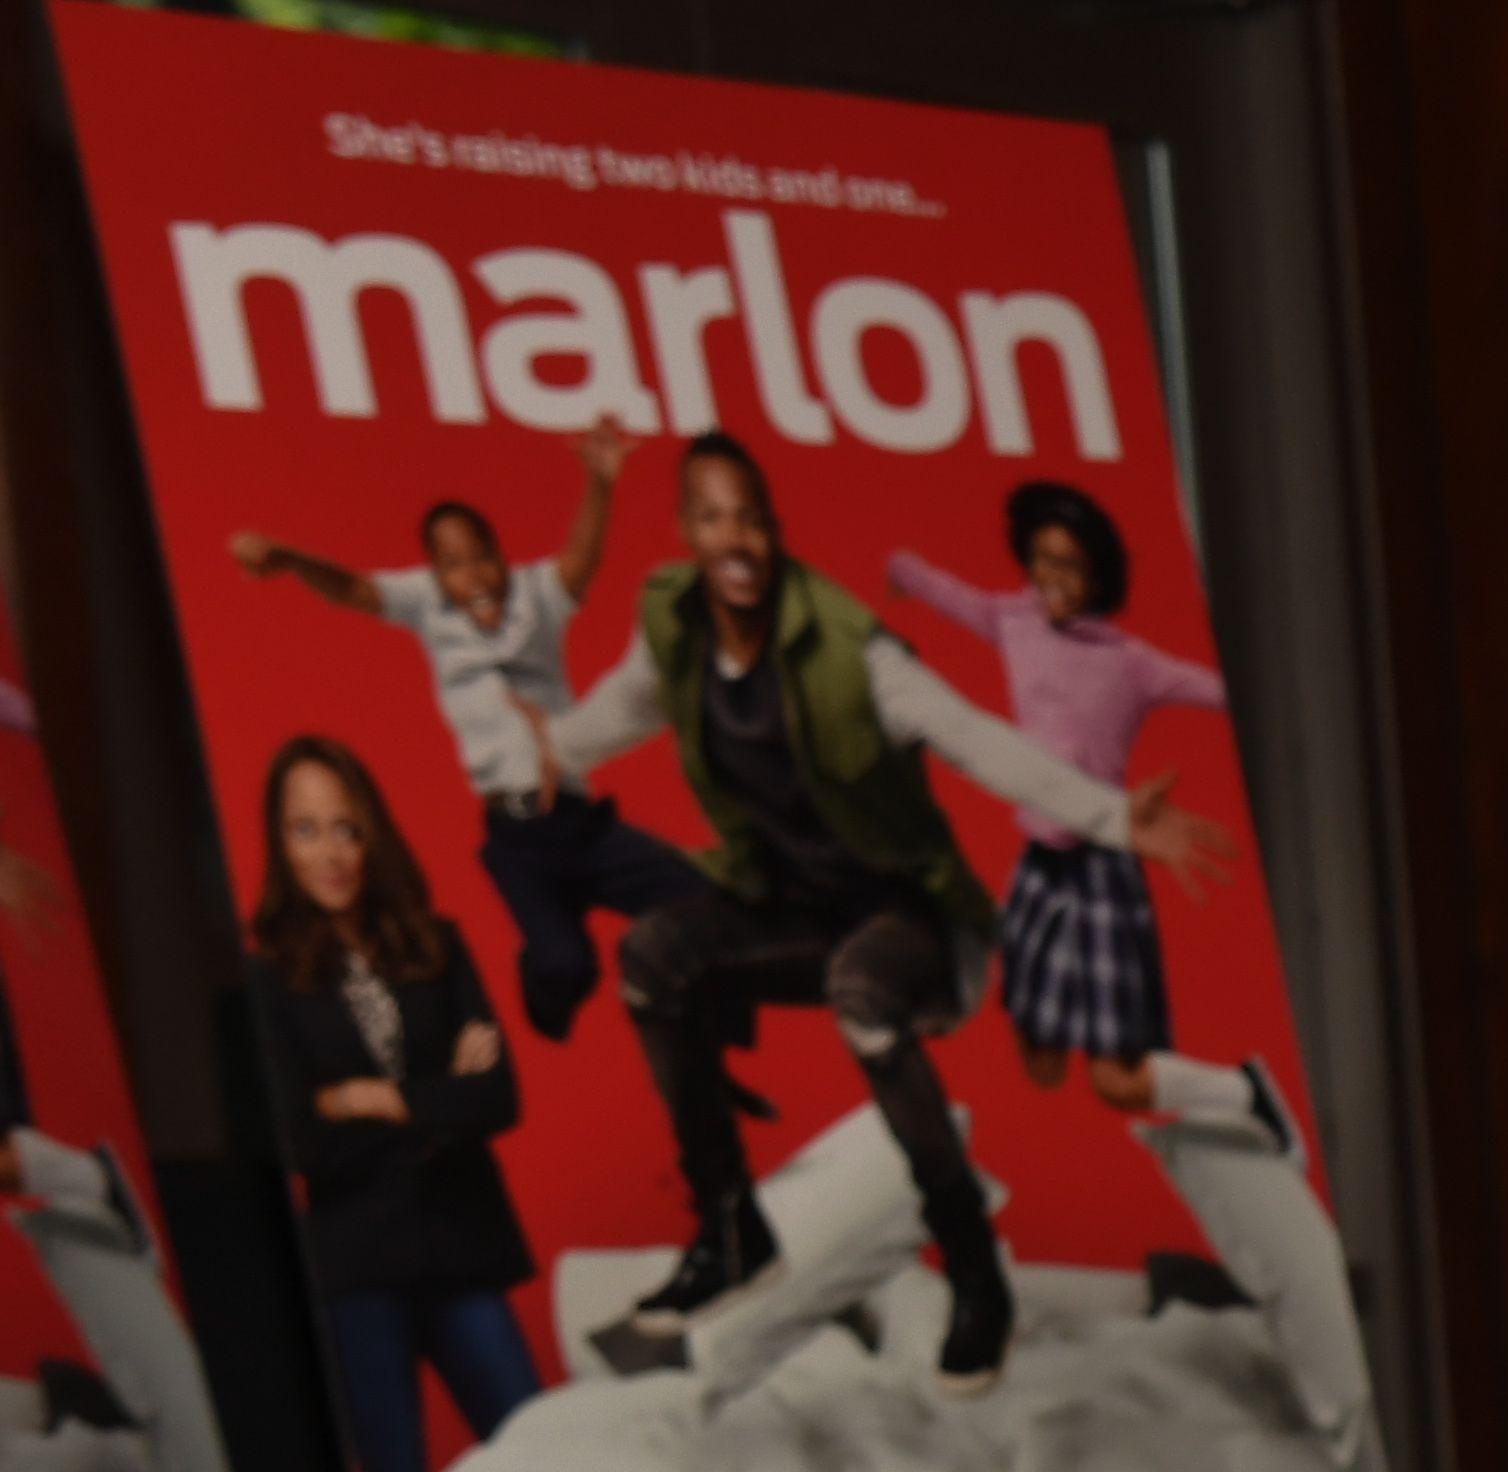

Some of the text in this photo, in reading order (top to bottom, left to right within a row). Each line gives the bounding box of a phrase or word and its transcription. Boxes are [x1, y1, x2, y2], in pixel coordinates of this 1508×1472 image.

[322, 111, 449, 168] She's
[451, 130, 598, 191] raising
[599, 144, 677, 191] two
[677, 151, 761, 199] kids
[766, 166, 841, 208] and
[168, 208, 1122, 463] marlon
